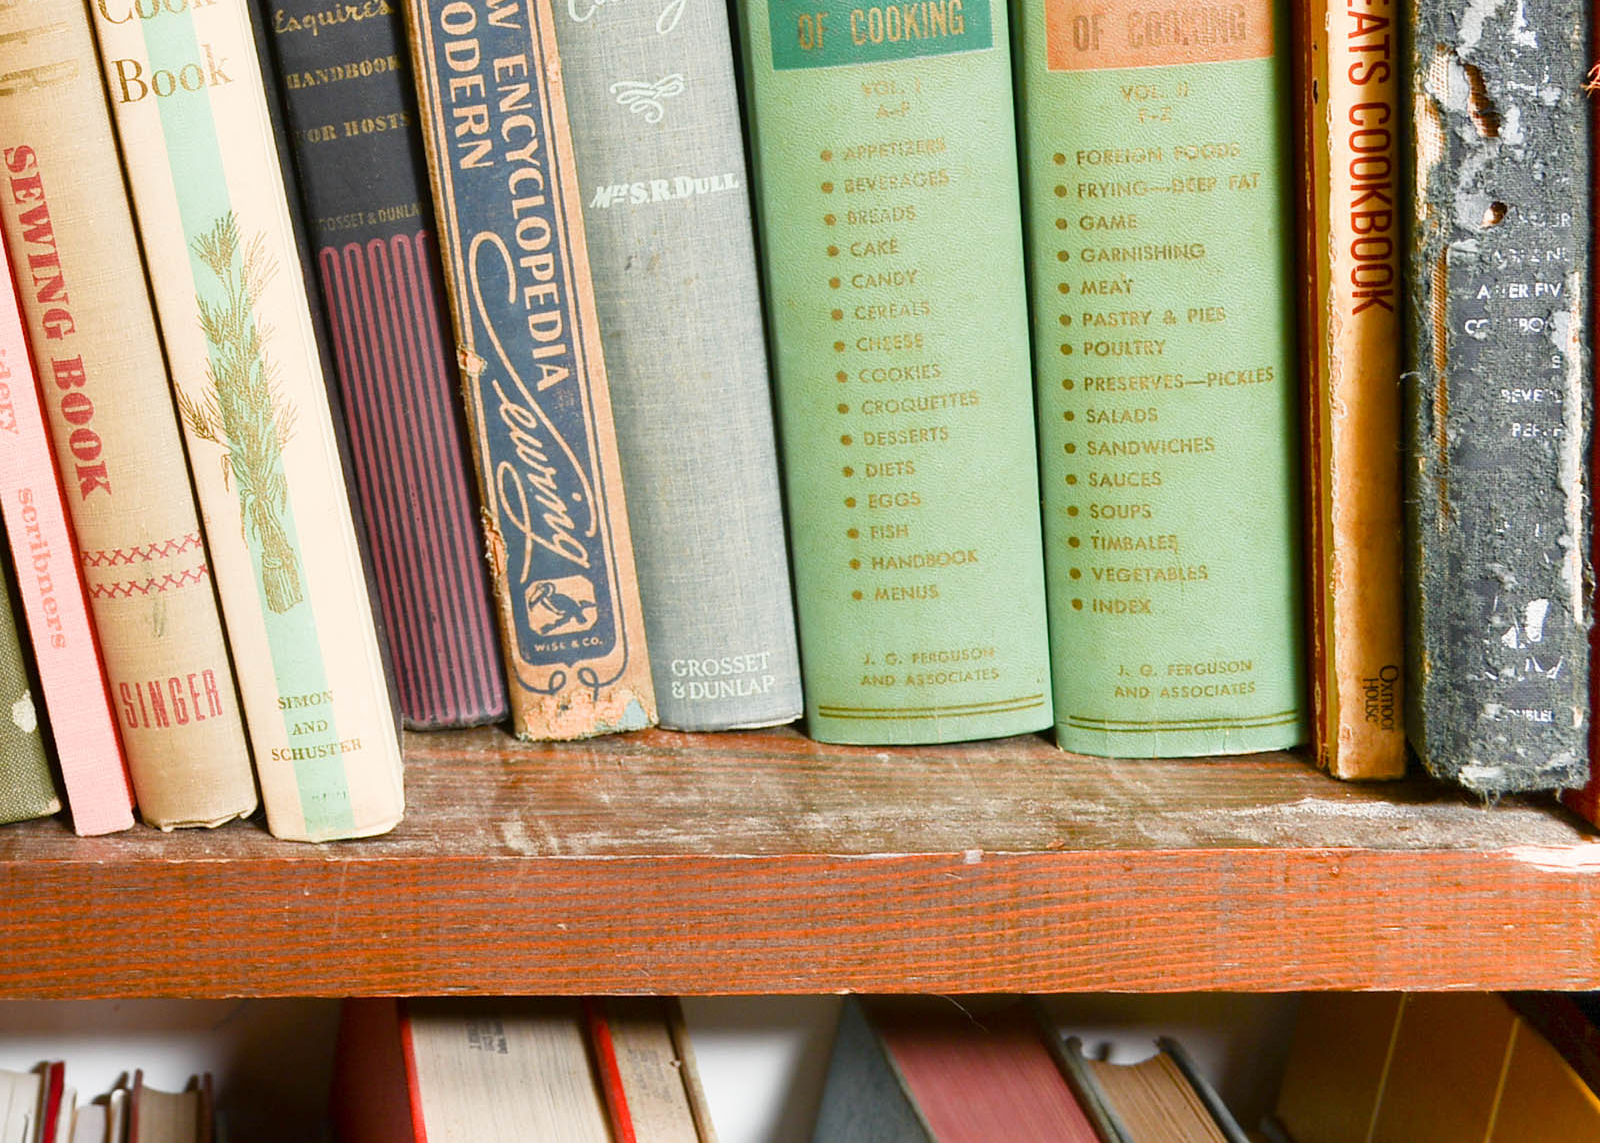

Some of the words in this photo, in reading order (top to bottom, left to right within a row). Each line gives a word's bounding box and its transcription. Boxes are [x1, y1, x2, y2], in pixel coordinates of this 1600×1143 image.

[797, 12, 829, 50] OF
[1073, 13, 1105, 51] OF
[111, 43, 234, 104] Book
[285, 54, 401, 90] HANDBOOK
[343, 112, 410, 138] HOSTS
[843, 137, 946, 160] APPETIZERS
[1077, 146, 1163, 166] FOREIGN
[1174, 142, 1241, 160] FOODS
[844, 169, 949, 194] BEVERAGES
[1229, 172, 1260, 191] FAT
[847, 205, 917, 225] BREADS
[1348, 101, 1394, 316] COOKBOOK
[493, 53, 570, 392] ENCYCLOPEDIA
[1079, 214, 1137, 231] GAME
[850, 238, 899, 257] CAKE
[1080, 243, 1206, 263] GARNISHING
[851, 270, 918, 289] CANDY
[1080, 277, 1134, 295] MEAT
[855, 301, 931, 321] CEREALS
[1082, 310, 1152, 327] PASTRY
[1163, 310, 1176, 325] &
[1187, 307, 1226, 323] PIES
[3, 144, 77, 342] SEWING
[51, 353, 112, 502] BOOK
[856, 334, 924, 352] CHEESE
[1084, 339, 1166, 357] POULTRY
[858, 363, 941, 383] COOKIES
[862, 390, 980, 416] CROQUETTES
[1086, 408, 1158, 424] SALADS
[863, 426, 949, 446] DESSERTS
[1087, 437, 1215, 456] SANDWICHES
[865, 460, 916, 478] DIETS
[1089, 471, 1162, 487] SAUCES
[867, 491, 922, 509] EGGS
[1090, 504, 1151, 520] SOUPS
[870, 524, 909, 540] FISH
[1091, 534, 1178, 552] TIMBALES
[17, 486, 67, 651] scribners
[871, 549, 979, 571] HANDBOOK
[1091, 565, 1208, 583] VEGETABLES
[875, 584, 940, 601] MENUS
[1092, 598, 1151, 614] INDEX
[583, 637, 603, 648] CO.
[671, 652, 770, 678] GROSSET
[912, 647, 996, 665] FERGUSON
[1167, 659, 1252, 676] FERGUSON
[671, 682, 685, 698] &
[689, 676, 776, 700] DUNLAP
[860, 673, 896, 687] AND
[905, 668, 1000, 688] ASSOCIATES
[119, 669, 223, 730] SINGER
[1114, 685, 1151, 699] AND
[1159, 681, 1255, 698] ASSOCIATES
[277, 690, 334, 711] SIMON
[292, 720, 328, 736] AND
[271, 737, 362, 762] SCHUSTER
